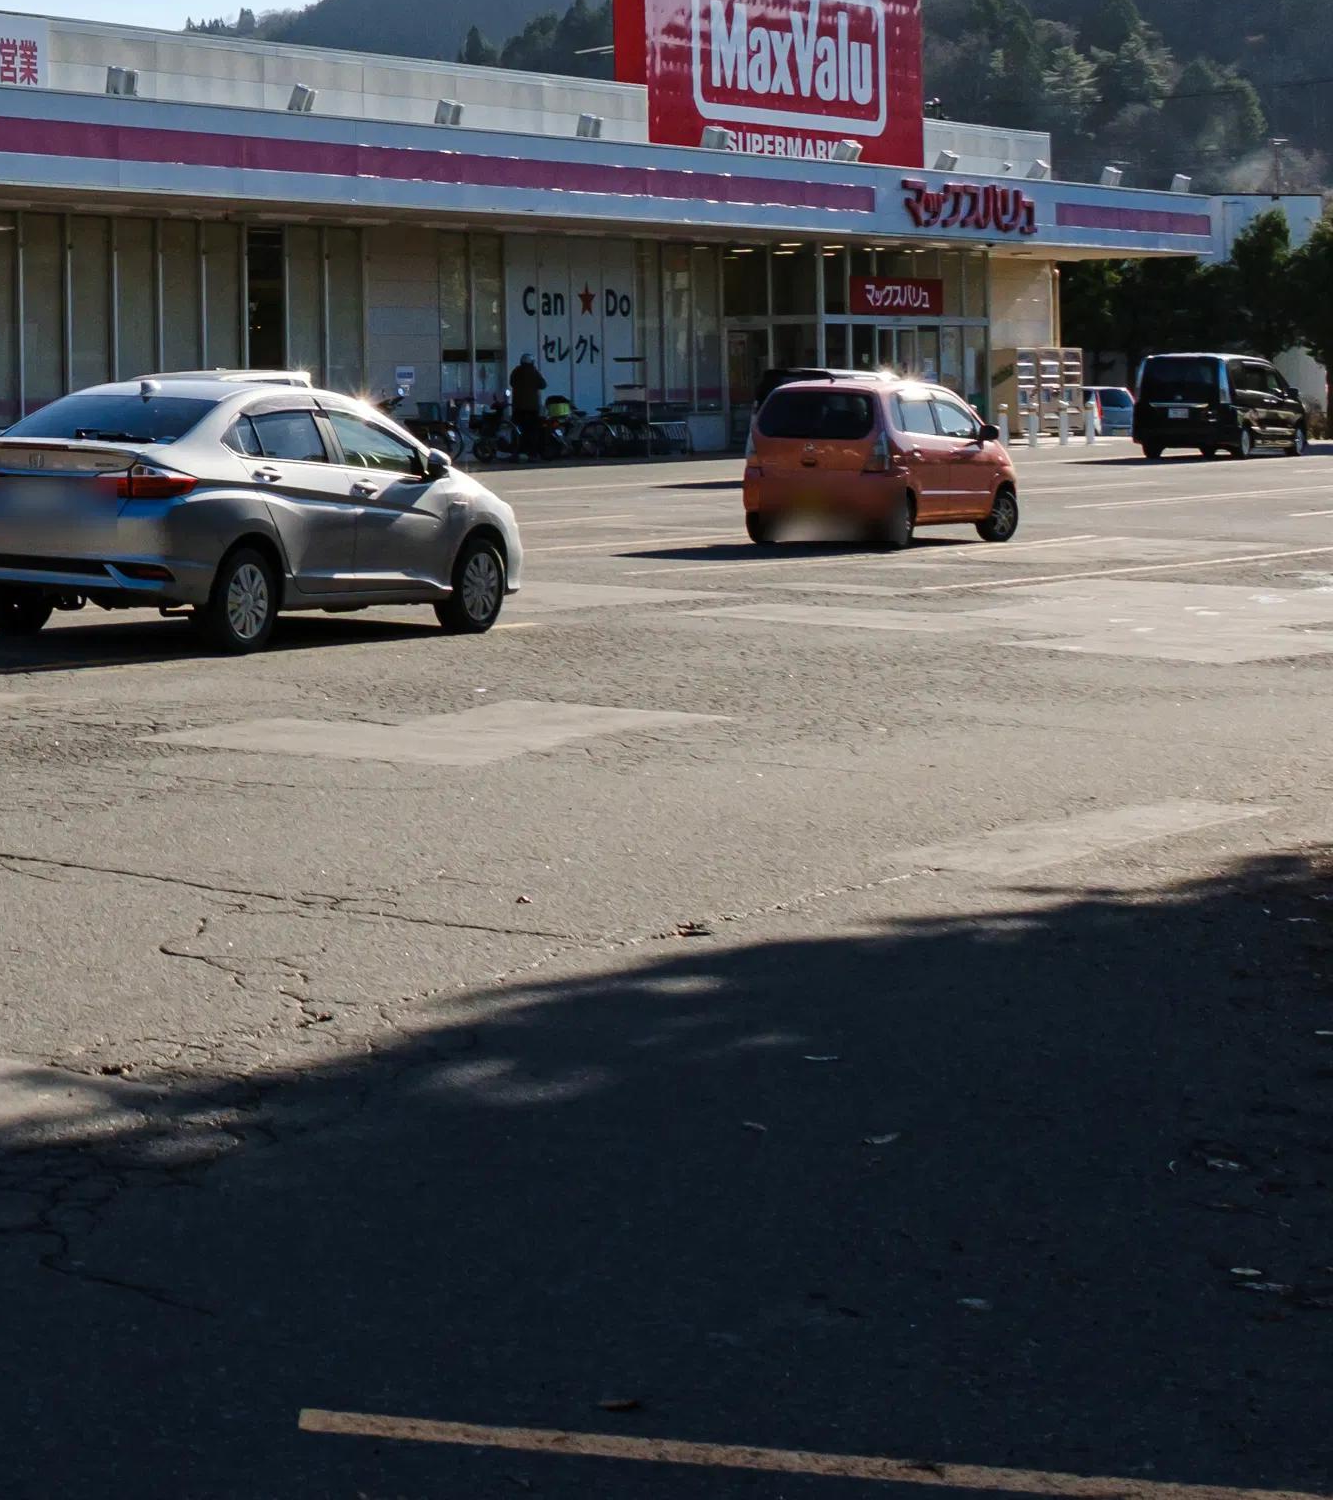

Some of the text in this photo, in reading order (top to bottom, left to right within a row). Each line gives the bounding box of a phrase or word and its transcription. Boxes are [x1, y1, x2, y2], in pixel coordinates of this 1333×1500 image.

[901, 178, 1038, 236] マックスバリュ
[522, 285, 631, 317] Can Do
[865, 284, 930, 308] マックスバリュ
[542, 334, 600, 364] セレクト
